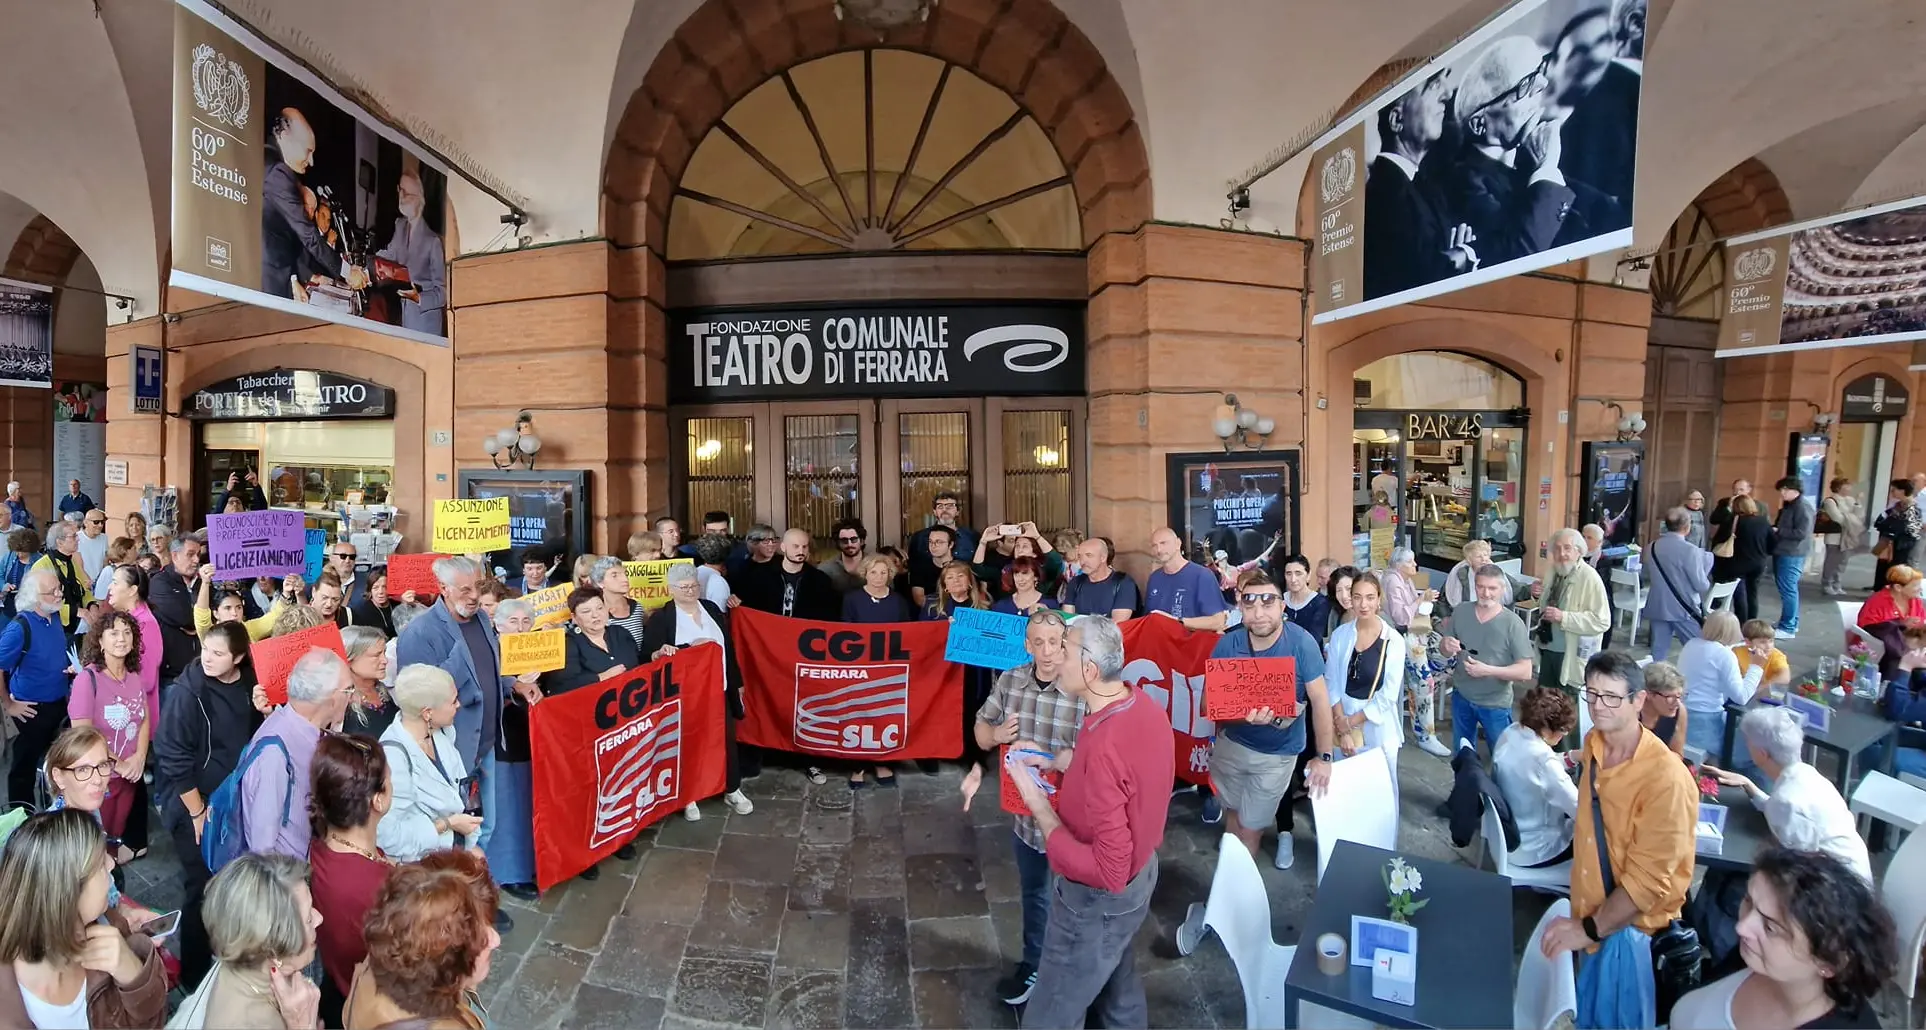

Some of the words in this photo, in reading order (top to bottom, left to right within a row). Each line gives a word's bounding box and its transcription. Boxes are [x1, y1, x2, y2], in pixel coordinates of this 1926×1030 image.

[192, 148, 247, 187] Premio
[192, 167, 249, 205] Estense
[1322, 224, 1354, 244] Premio
[1322, 236, 1355, 256] Estense
[1730, 303, 1770, 314] Estense
[1731, 294, 1770, 306] Premio
[710, 319, 811, 335] FONDAZIONE
[822, 316, 949, 350] COMUNALE
[686, 323, 812, 387] TEATRO
[824, 352, 844, 384] DI
[854, 350, 949, 383] FERRARA
[136, 397, 161, 409] LOTTO
[286, 384, 368, 409] TATRO
[1409, 413, 1450, 439] BAR
[441, 498, 505, 512] ASSUNZIONE
[1245, 496, 1266, 509] OPERA
[436, 524, 510, 541] LICENZIAMENTO
[508, 632, 559, 650] PENSATI
[798, 629, 910, 662] CGIL
[800, 668, 869, 679] FERRARA
[1207, 659, 1259, 672] BASTA
[595, 662, 680, 729] CGIL
[600, 717, 653, 754] FERRARA
[842, 724, 899, 749] SLC
